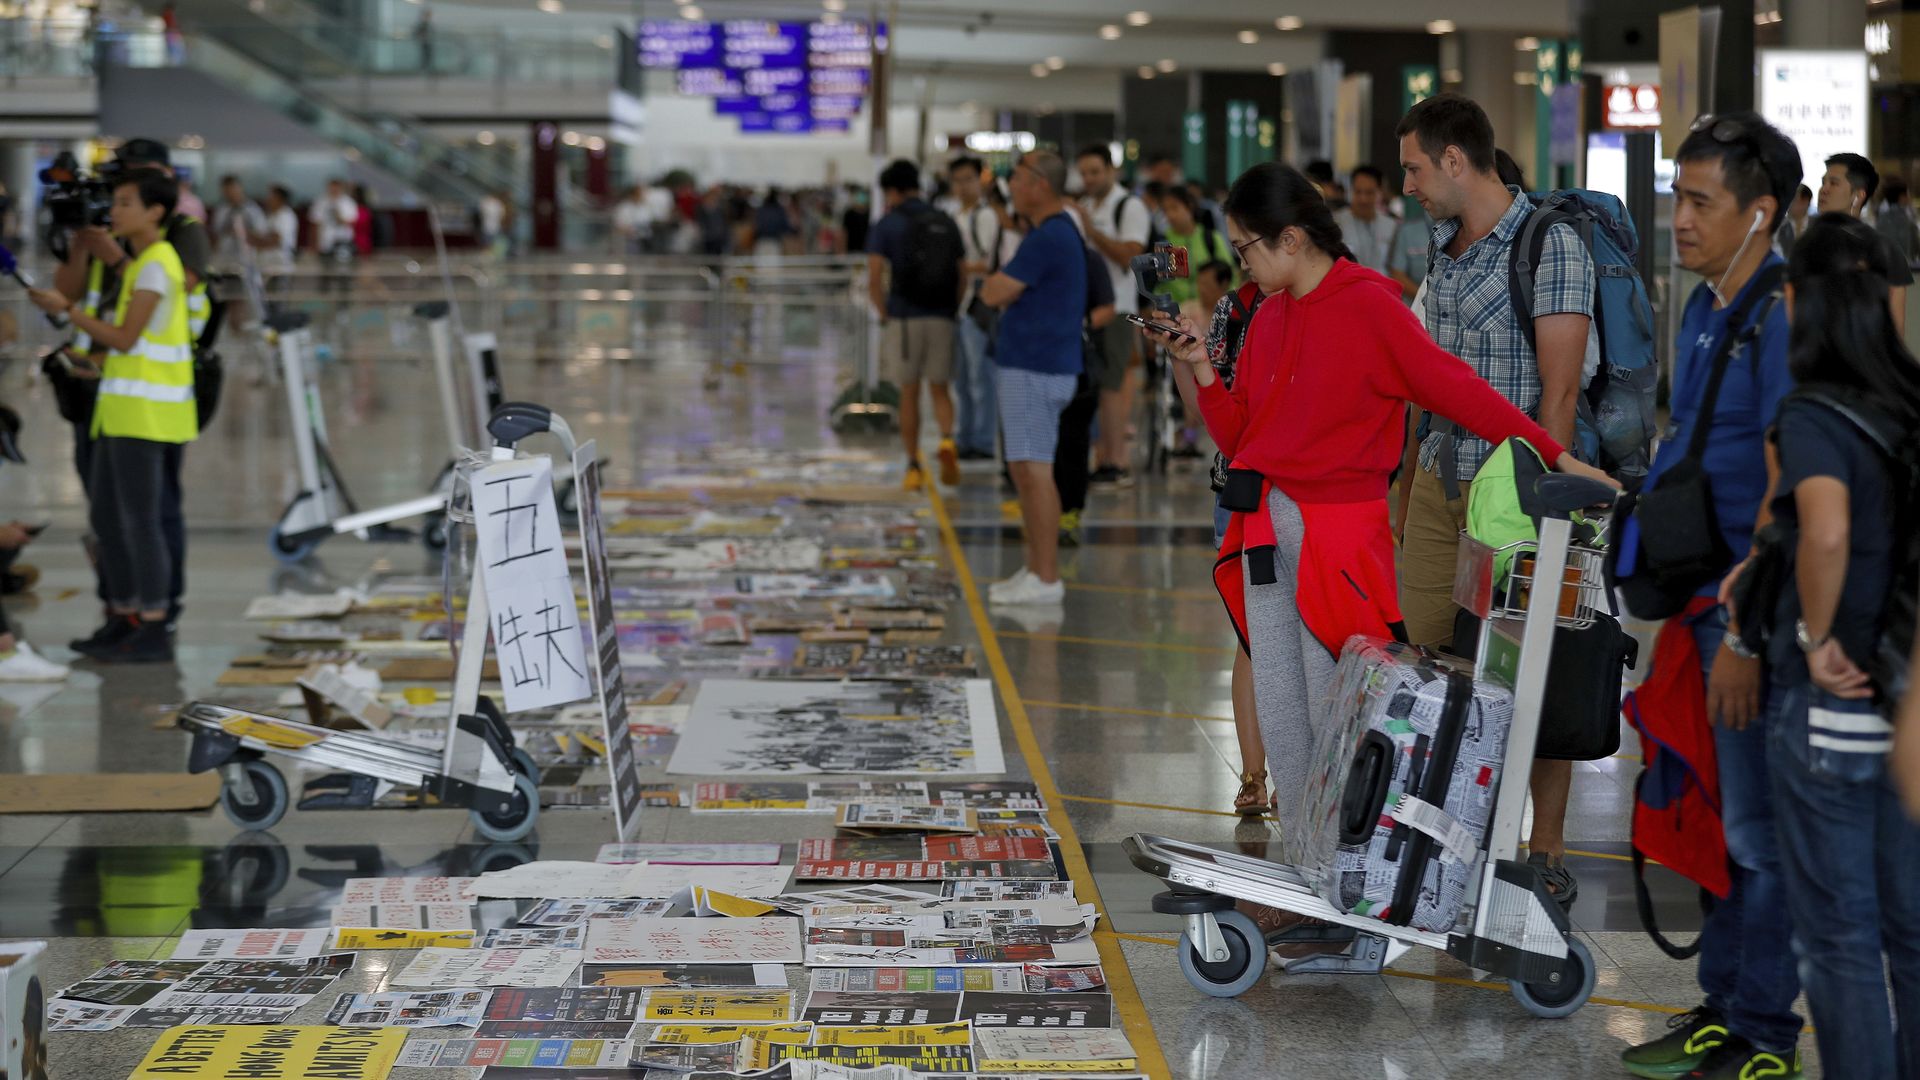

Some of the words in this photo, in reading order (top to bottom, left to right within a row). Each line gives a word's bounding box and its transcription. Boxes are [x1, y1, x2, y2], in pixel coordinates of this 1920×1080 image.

[1393, 794, 1408, 813] HKG
[154, 1029, 226, 1063] BETTER
[246, 1028, 301, 1049] KONG
[146, 1065, 201, 1073] A
[224, 1050, 286, 1079] HONG
[302, 1040, 378, 1079] AWAITS
